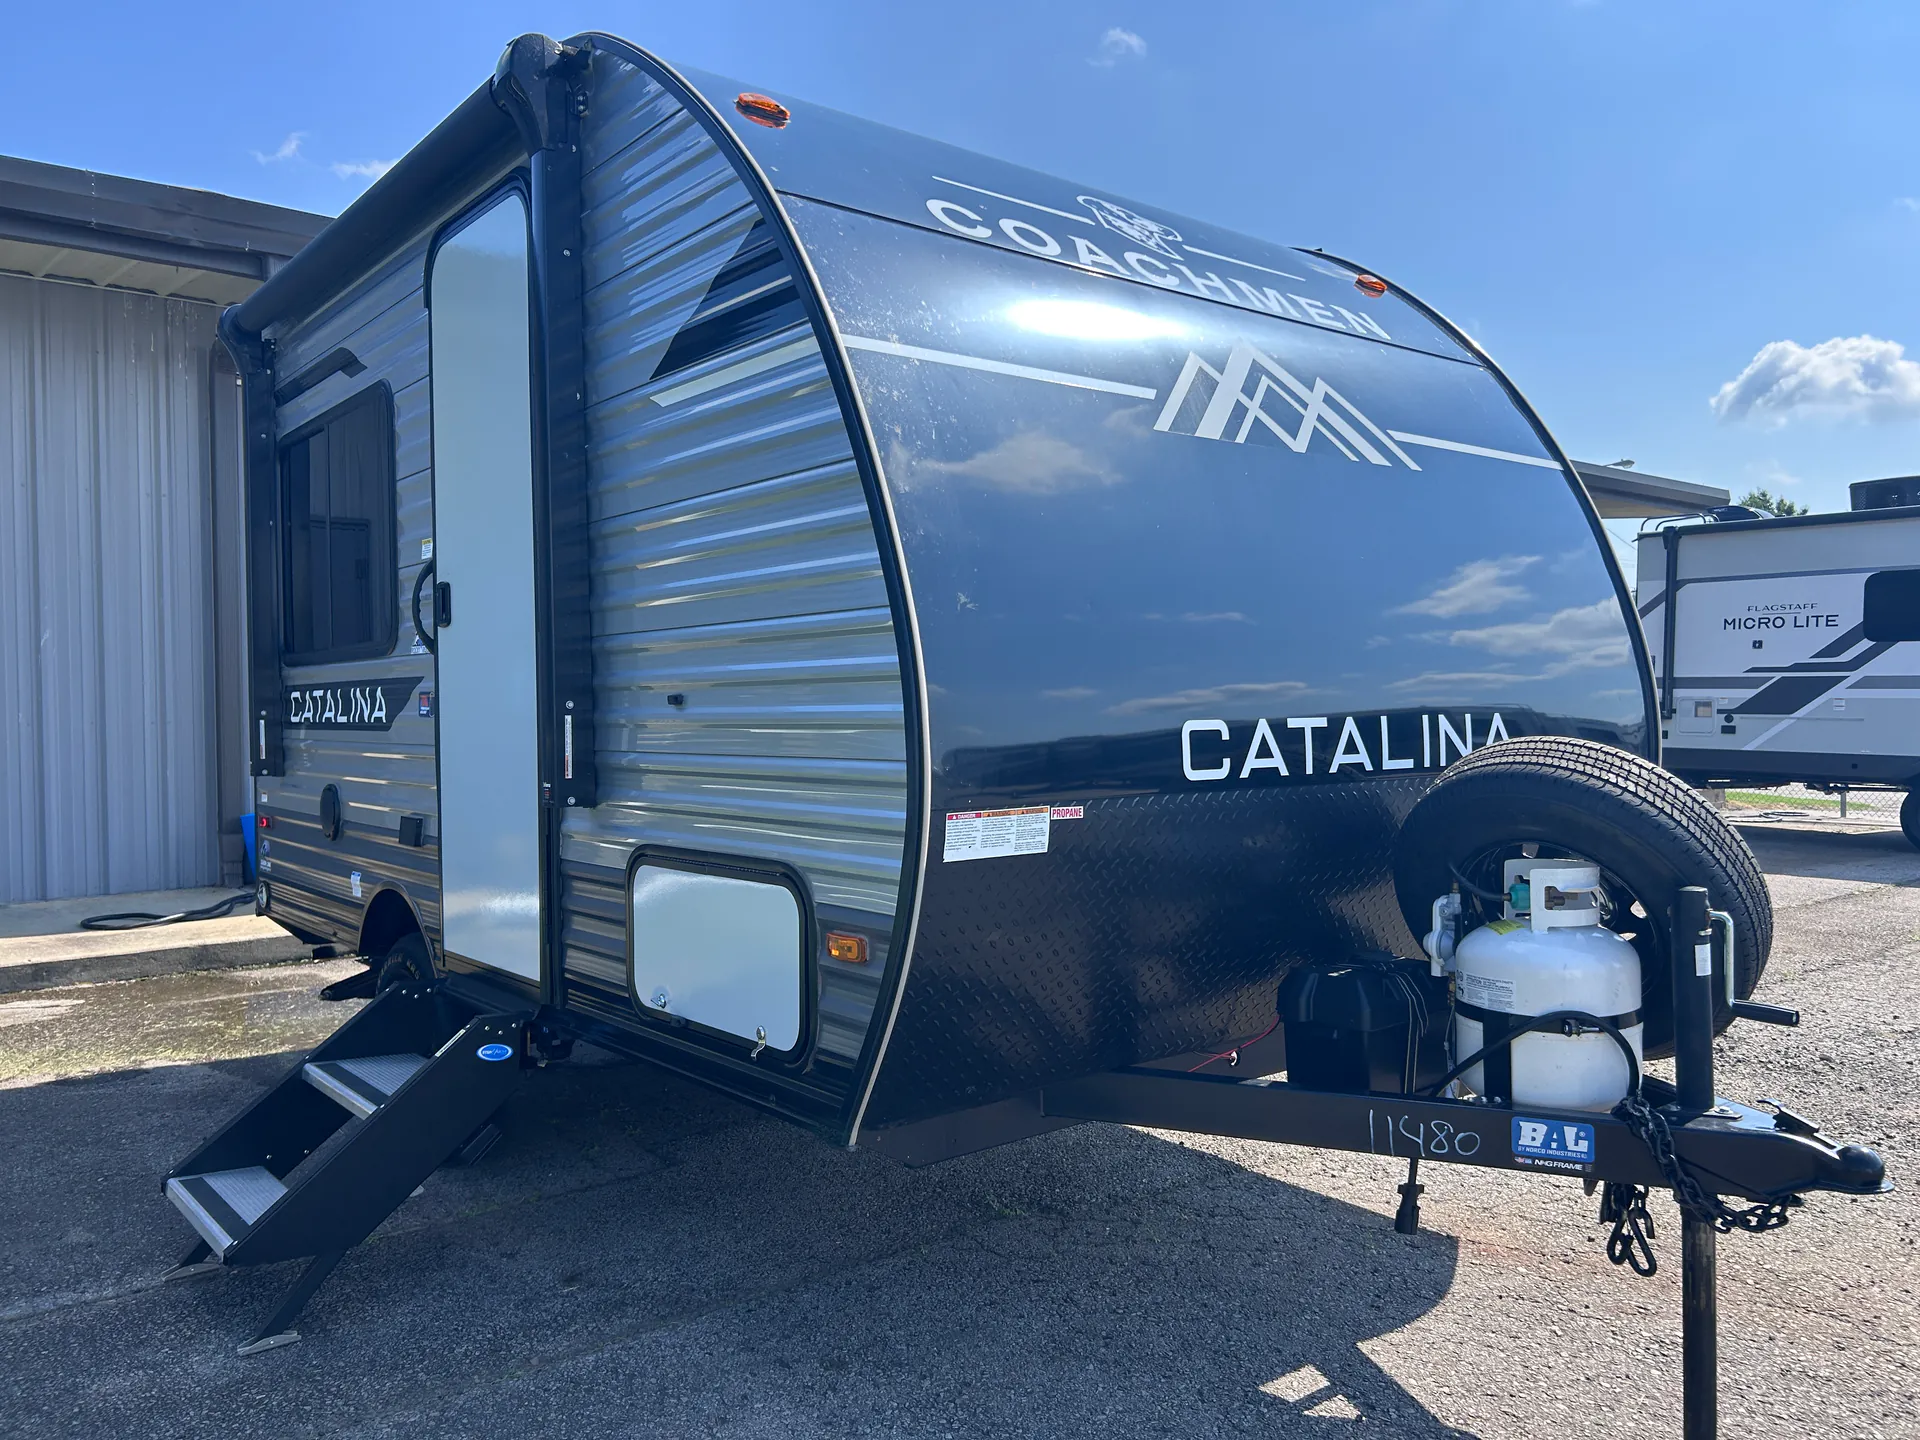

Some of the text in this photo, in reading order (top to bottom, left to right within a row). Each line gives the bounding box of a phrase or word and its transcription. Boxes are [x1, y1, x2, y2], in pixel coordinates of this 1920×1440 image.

[926, 199, 1391, 339] COACHMEN
[1747, 603, 1818, 612] FLAGSTAFF
[1723, 615, 1839, 630] MICRO LITE
[290, 686, 386, 723] CATALINA
[1052, 807, 1082, 818] PROPANE
[1369, 1109, 1480, 1157] 11480
[1526, 1146, 1546, 1154] NORCO
[1546, 1149, 1581, 1158] INDUSTRIES
